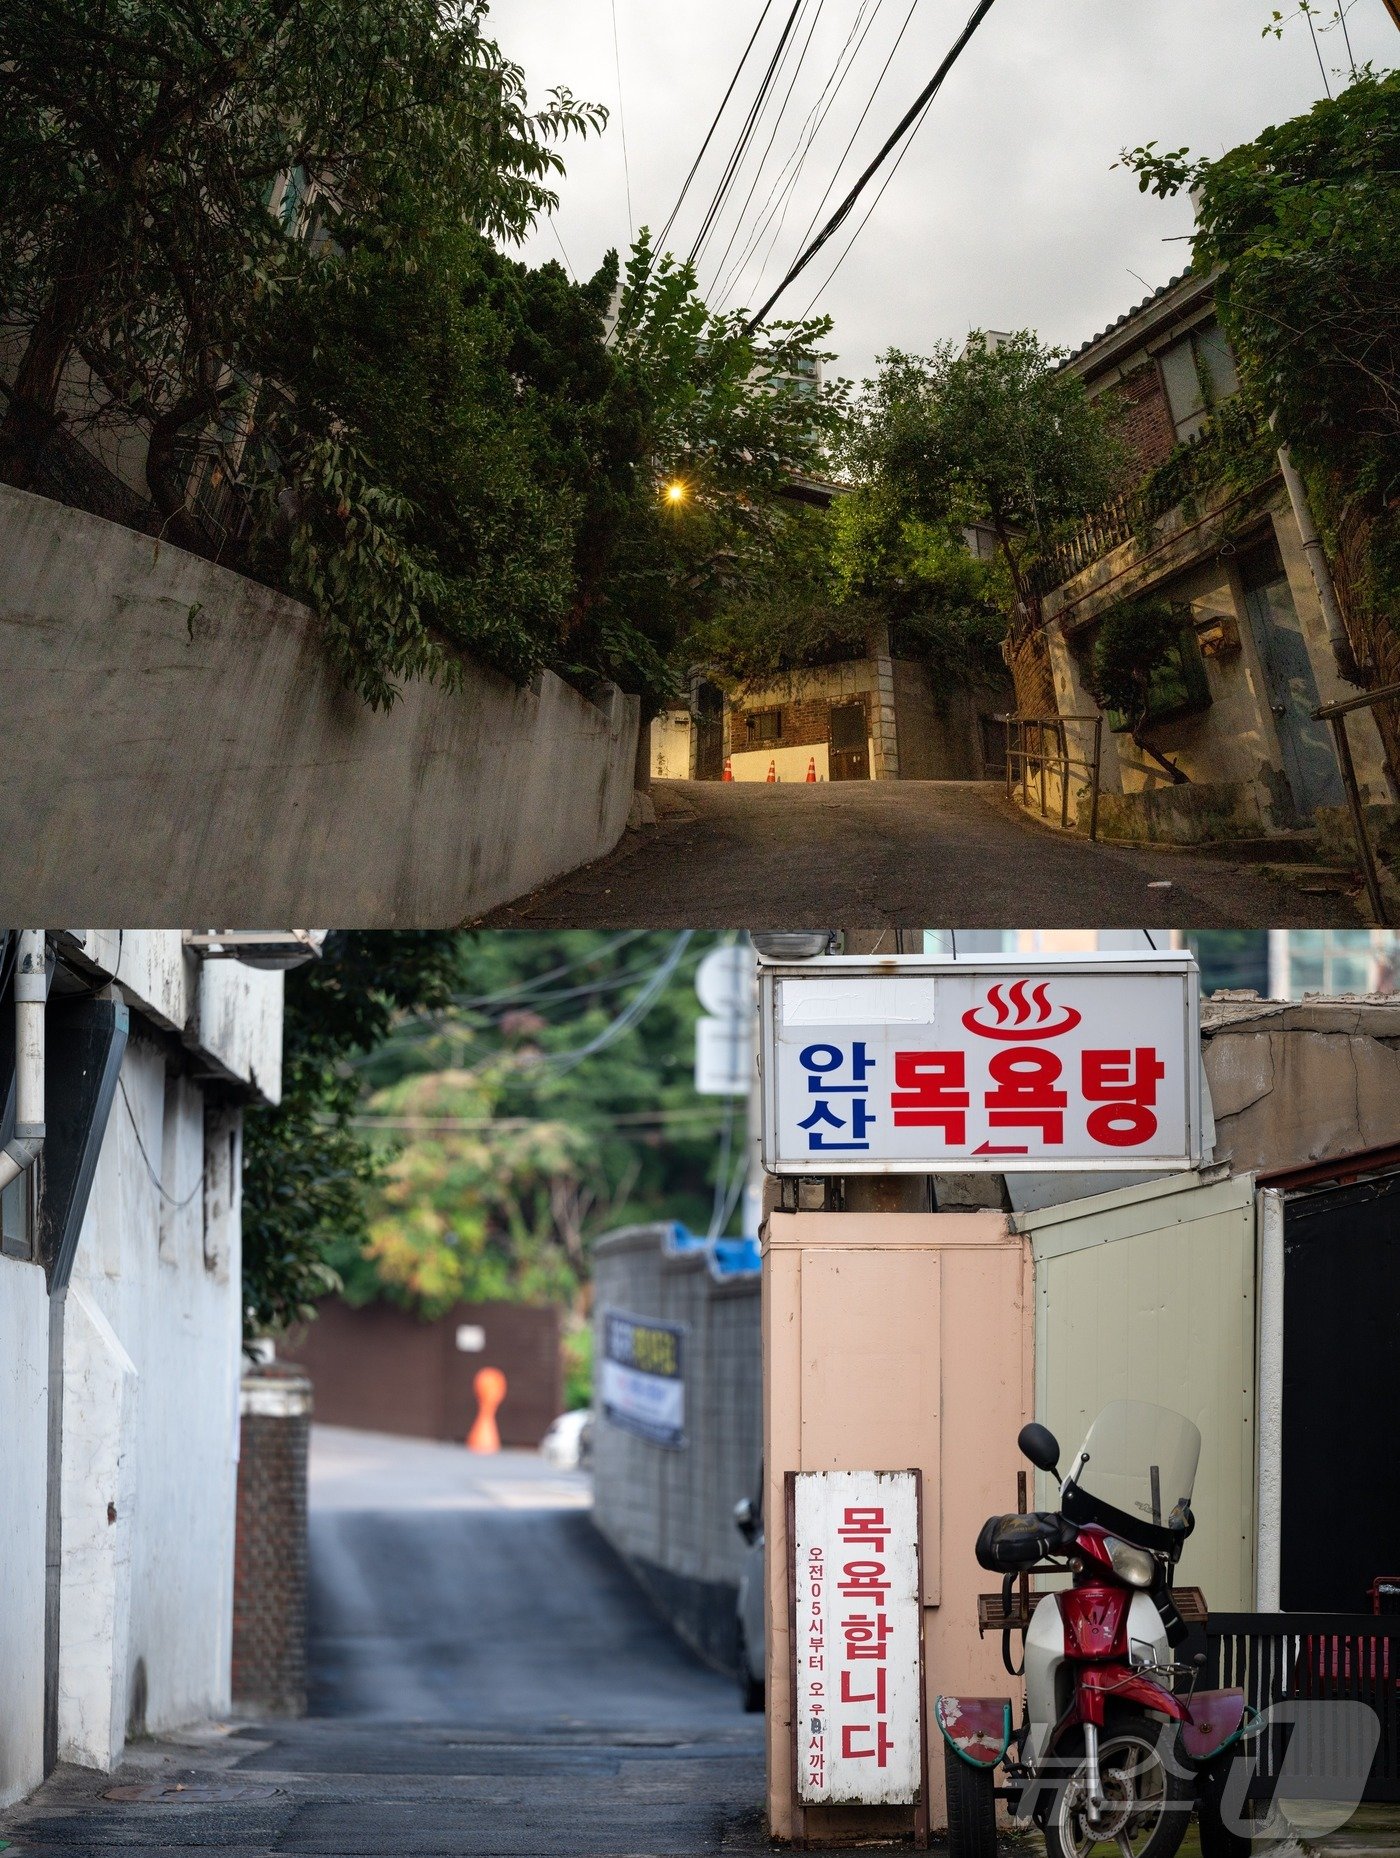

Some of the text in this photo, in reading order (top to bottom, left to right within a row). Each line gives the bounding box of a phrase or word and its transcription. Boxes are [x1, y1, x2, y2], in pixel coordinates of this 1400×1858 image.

[796, 1041, 1165, 1151] 안산 목욕탕
[837, 1507, 894, 1768] 목욕합니다
